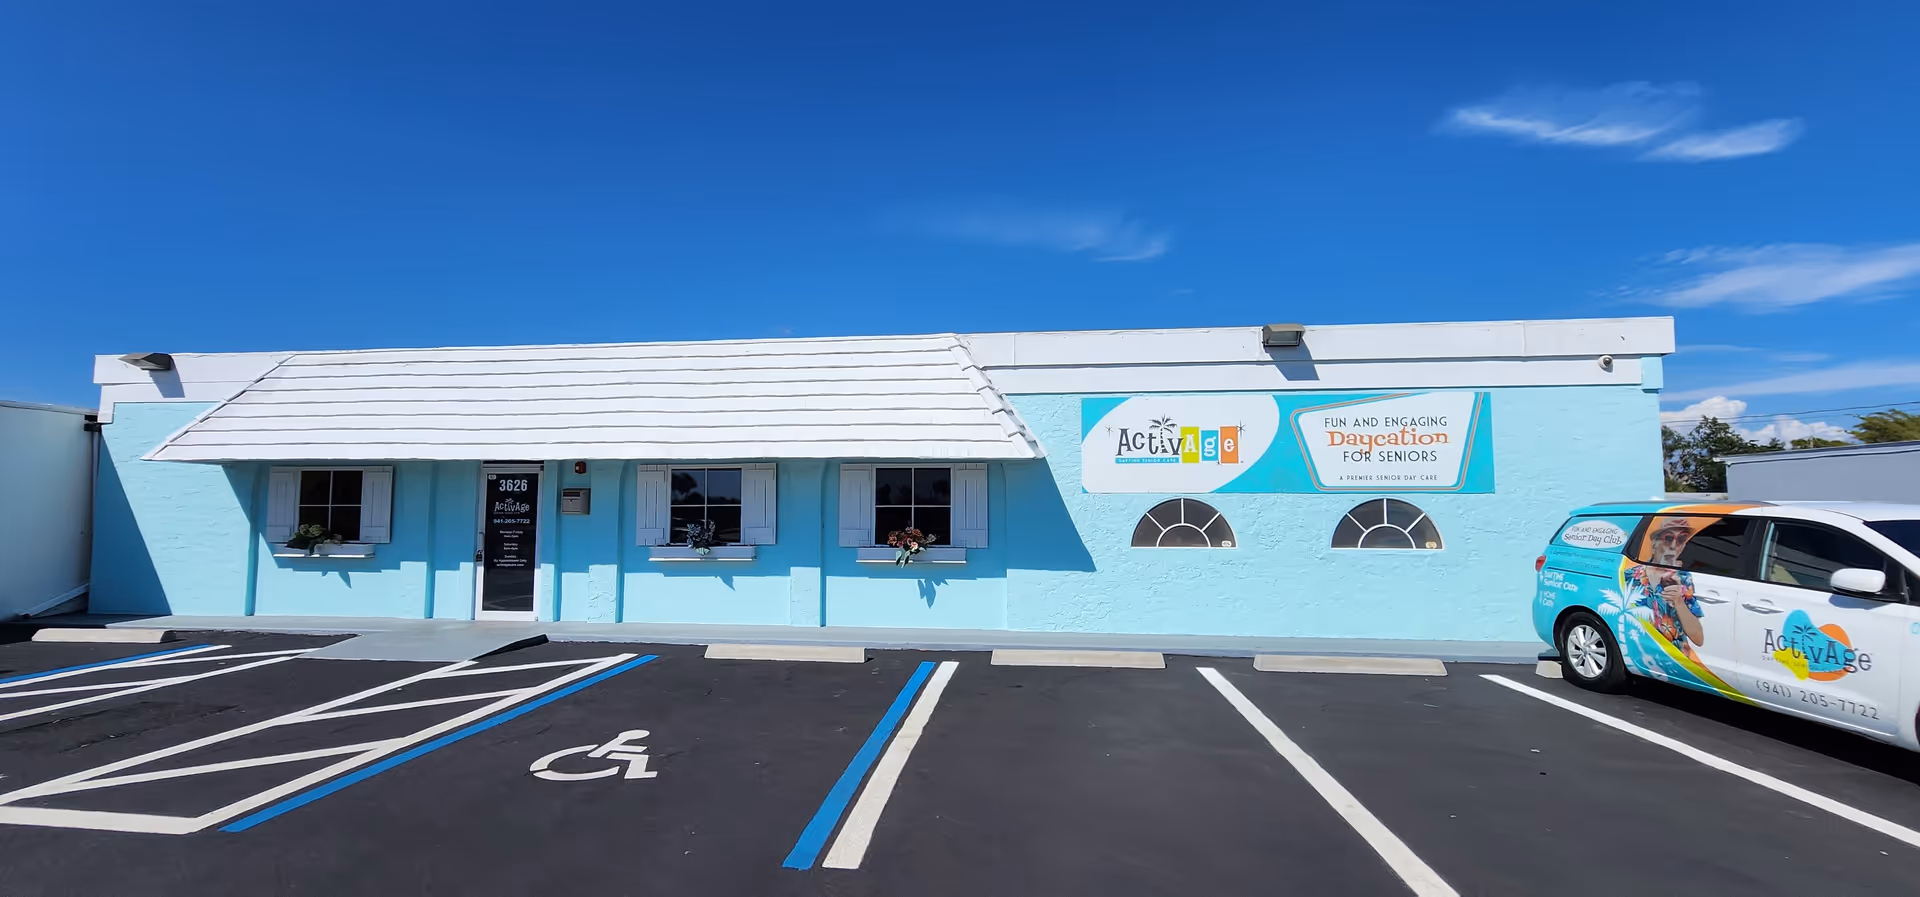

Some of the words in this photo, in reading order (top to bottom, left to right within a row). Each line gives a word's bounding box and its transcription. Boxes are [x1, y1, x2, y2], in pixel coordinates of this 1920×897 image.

[1324, 417, 1347, 428] FUN
[1352, 417, 1379, 428] AND
[1384, 416, 1448, 427] ENGAGING
[1325, 425, 1449, 455] Daycation
[1343, 451, 1372, 462] FOR
[1378, 450, 1438, 462] SENIORS
[499, 479, 528, 492] 3626
[494, 501, 530, 512] ActivAge
[1563, 533, 1587, 541] Senior
[1587, 534, 1602, 546] Day
[1603, 534, 1622, 545] Club
[1762, 628, 1872, 673] ActivAge
[1756, 680, 1792, 698] (941)
[1800, 690, 1880, 720] 205-7722
